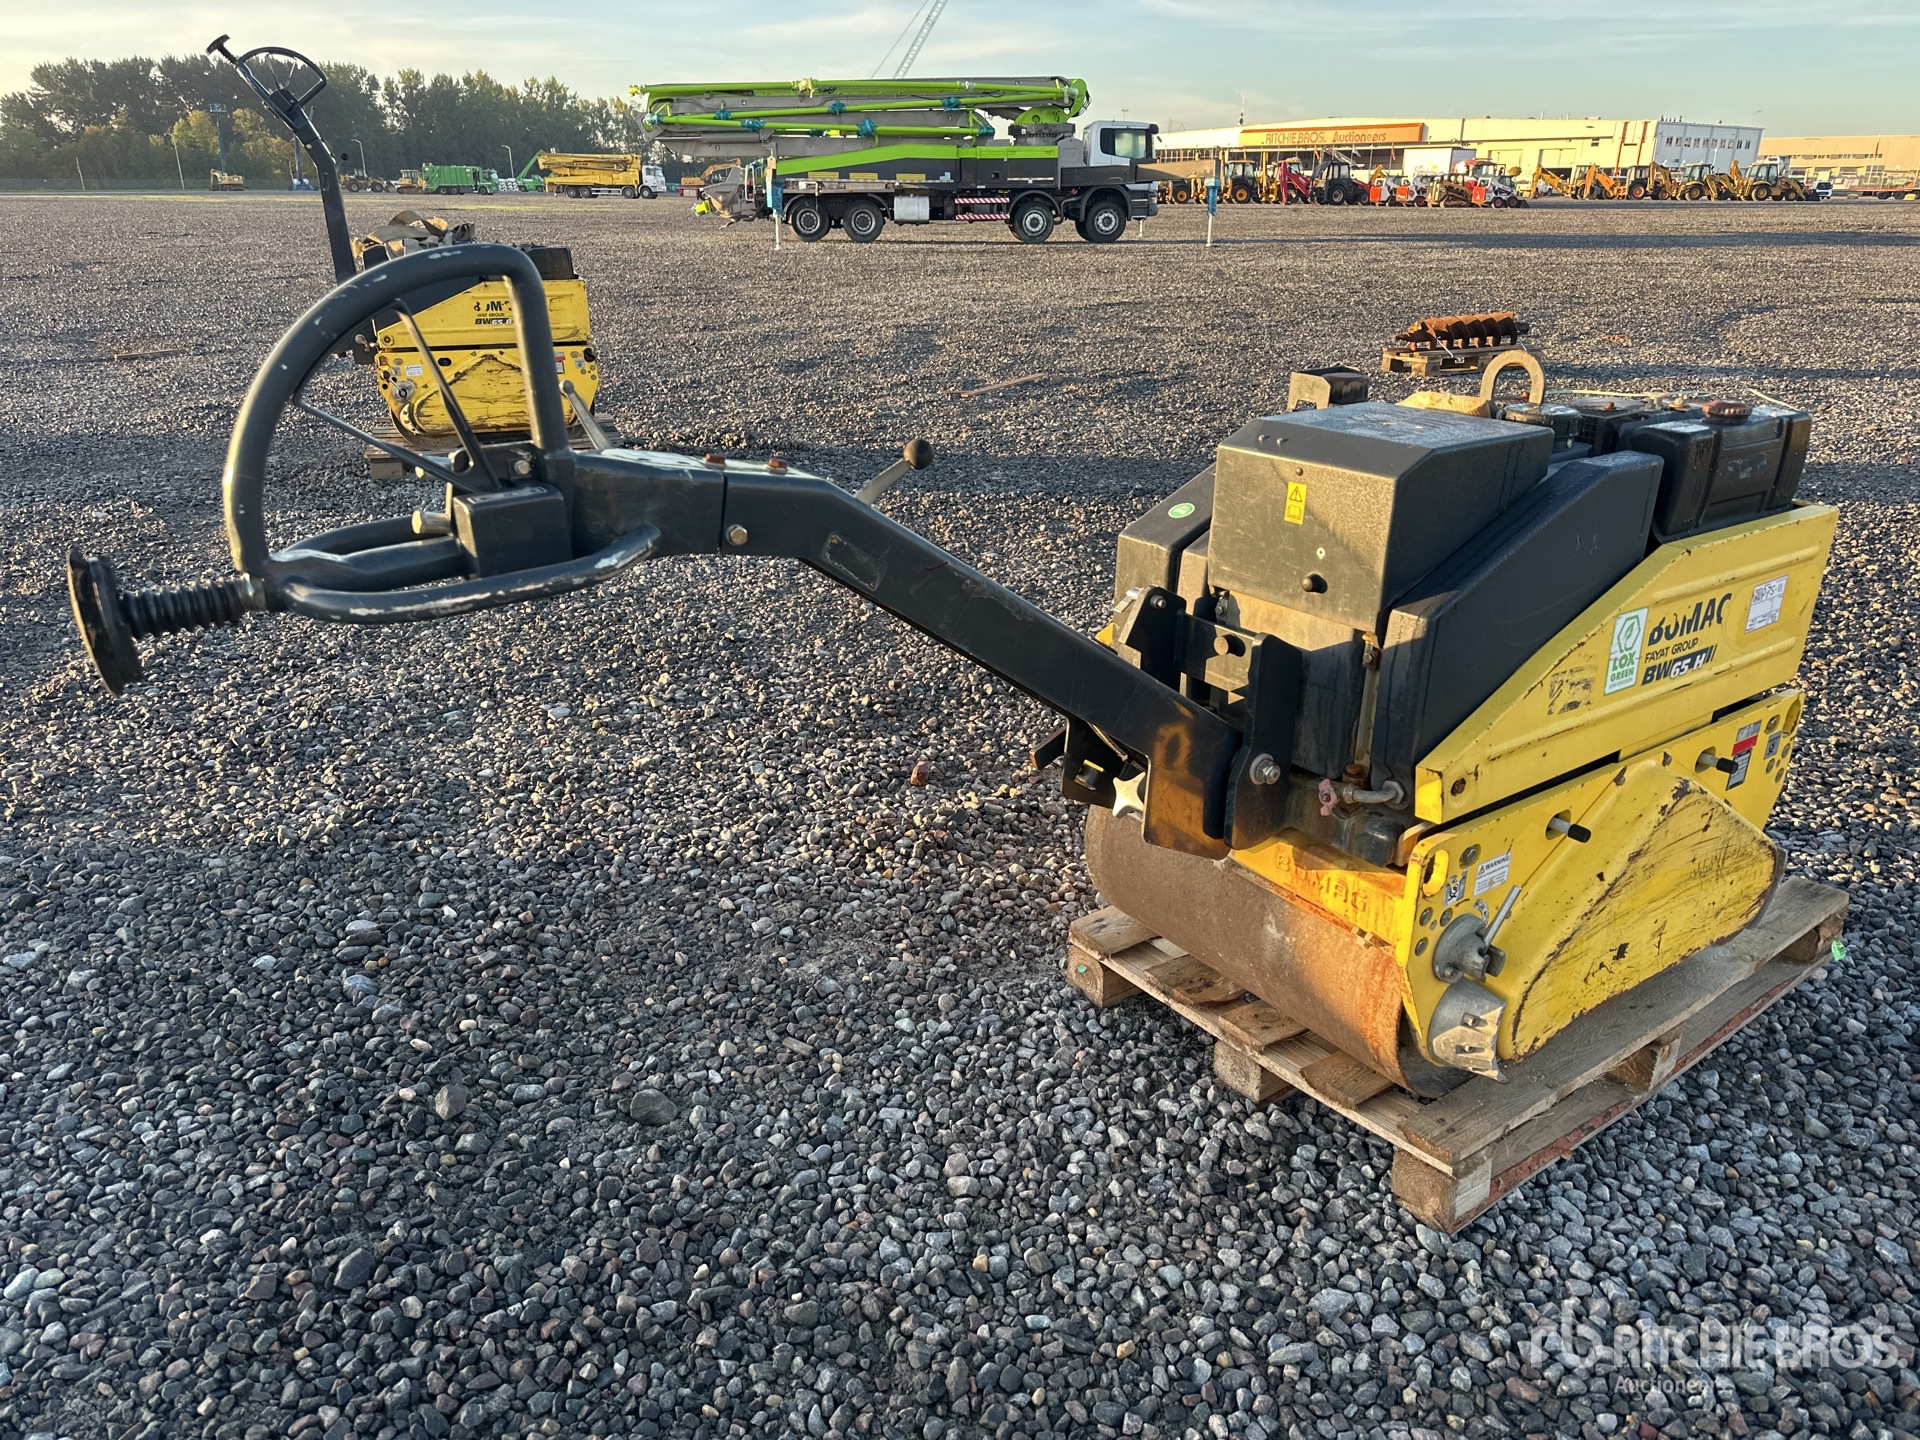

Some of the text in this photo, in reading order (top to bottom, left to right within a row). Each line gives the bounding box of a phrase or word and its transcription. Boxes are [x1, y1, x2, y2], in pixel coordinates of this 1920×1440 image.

[1265, 131, 1387, 145] RITCHIE BROS. Auctioneers
[1644, 637, 1699, 664] FAYAT GROUP
[1612, 650, 1636, 671] LOX
[1610, 666, 1635, 682] GREEN
[1485, 854, 1510, 870] WARNING
